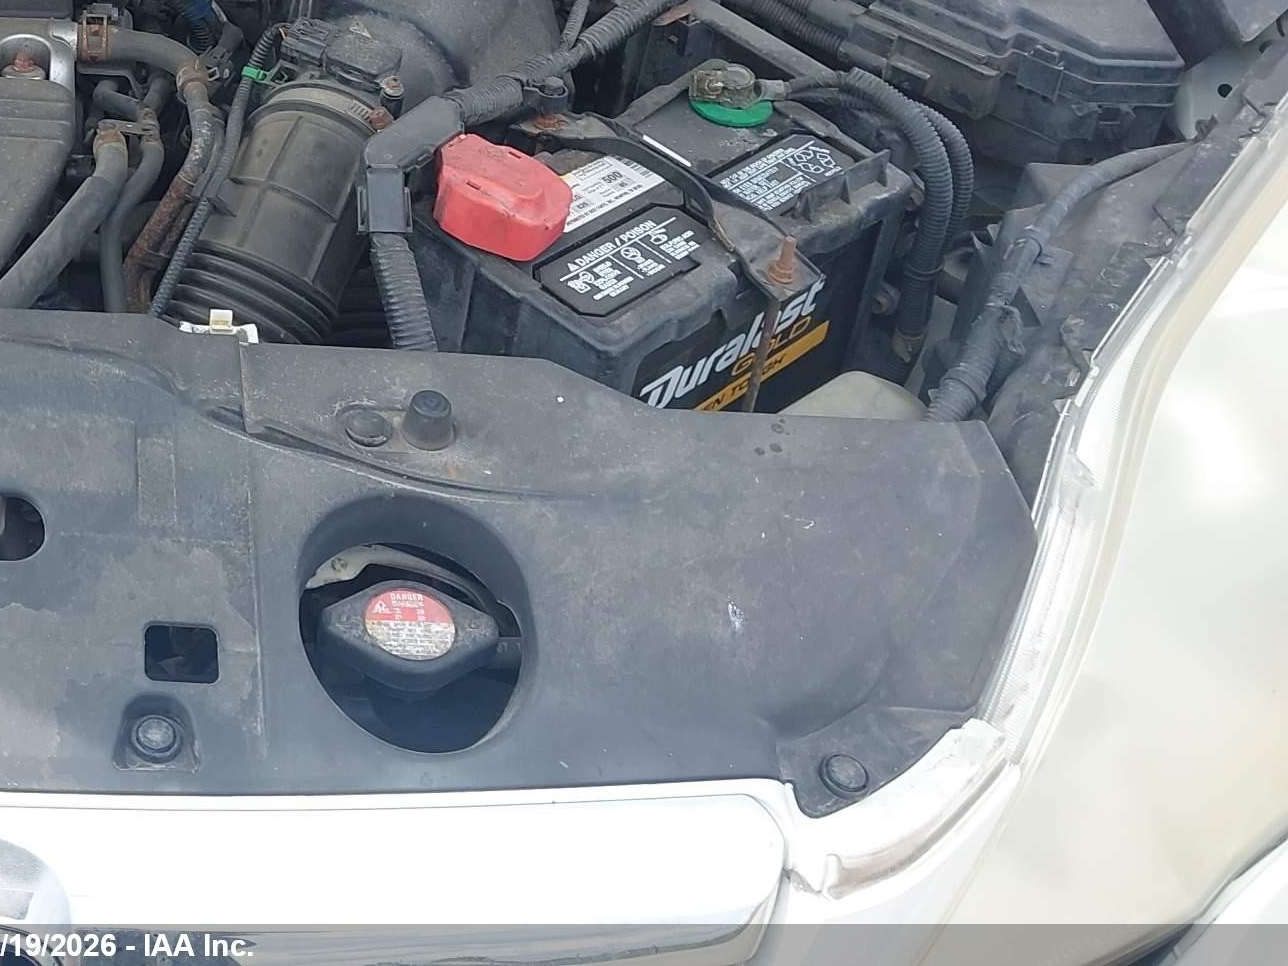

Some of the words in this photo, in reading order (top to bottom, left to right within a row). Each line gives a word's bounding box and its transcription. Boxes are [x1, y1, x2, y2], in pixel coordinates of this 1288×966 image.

[575, 242, 617, 267] DANGER
[620, 220, 657, 245] POISON
[390, 593, 424, 602] DANGER
